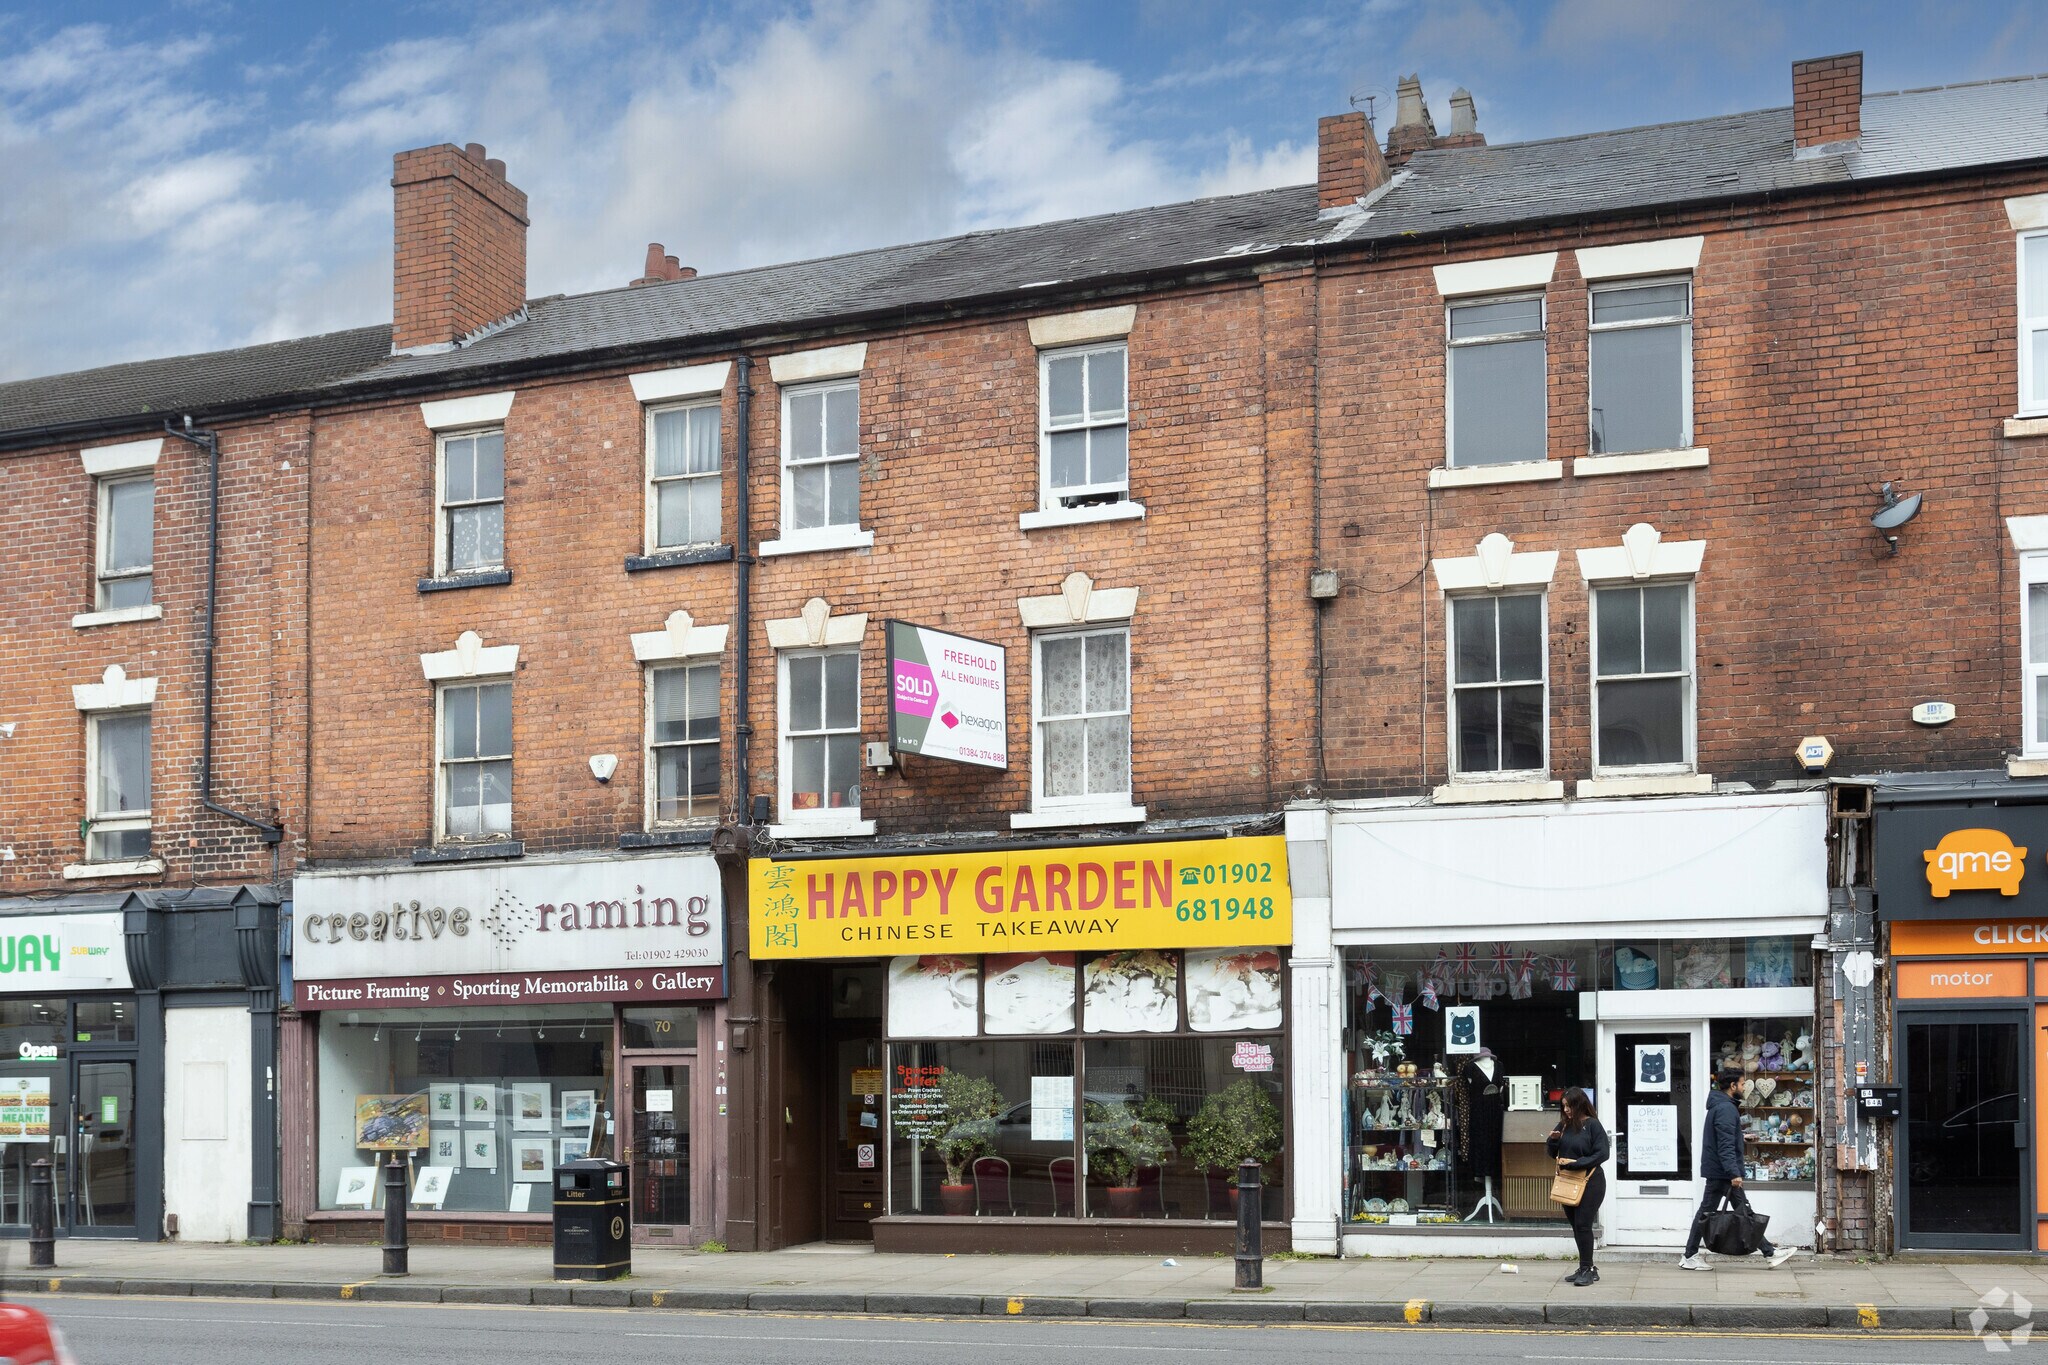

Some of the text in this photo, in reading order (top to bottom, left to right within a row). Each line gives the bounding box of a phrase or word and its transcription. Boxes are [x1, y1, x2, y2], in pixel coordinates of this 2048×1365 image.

[944, 649, 997, 672] FREEHOLD
[896, 674, 933, 697] SOLD
[941, 670, 1000, 690] ALL ENQUIRIES
[960, 711, 1003, 732] hexagon
[958, 746, 978, 758] 01384
[980, 749, 992, 760] 374
[993, 751, 1005, 763] 888
[1806, 748, 1824, 756] ADT
[1203, 862, 1272, 885] 01902
[807, 859, 1173, 920] HAPPY GARDEN
[302, 884, 710, 944] creative raming
[764, 865, 800, 949] 雲鴻閣
[1176, 896, 1274, 922] 681948
[841, 918, 1120, 942] CHINESE TAKEAWAY
[1973, 924, 2048, 945] CLICK
[70, 946, 110, 955] SUBWAY
[674, 948, 709, 958] 429030
[306, 972, 715, 1001] Picture Framing Sporting Memorabilia Gallery
[1930, 971, 1994, 986] motor
[655, 1020, 671, 1033] 70
[19, 1042, 58, 1060] Open
[1238, 1044, 1257, 1056] big
[1234, 1054, 1272, 1065] foodie
[897, 1065, 945, 1077] Special
[1098, 1074, 1133, 1084] OPEN
[904, 1076, 938, 1086] Offer
[2, 1114, 46, 1122] MEAN IT.
[1638, 1107, 1664, 1116] OPEN
[566, 1190, 586, 1198] Litter
